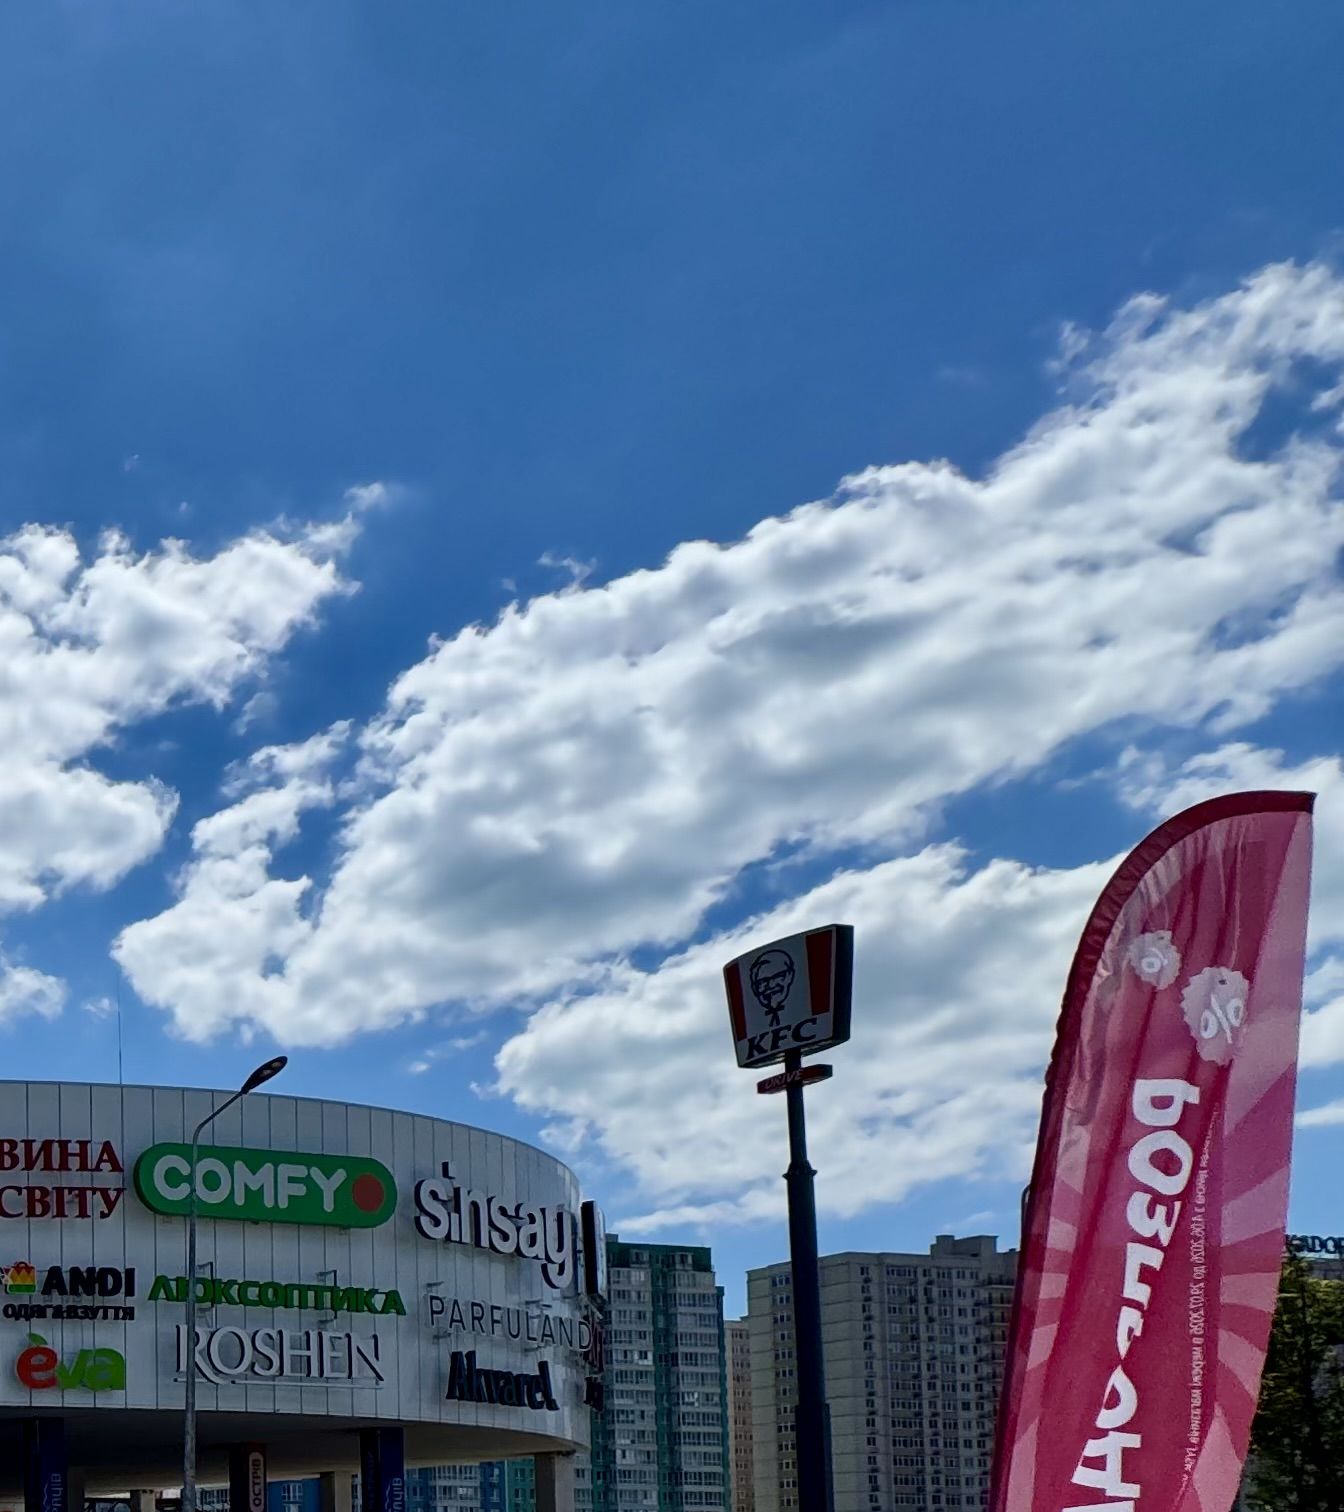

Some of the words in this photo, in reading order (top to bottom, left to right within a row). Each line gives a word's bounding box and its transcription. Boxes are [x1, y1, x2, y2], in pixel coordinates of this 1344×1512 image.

[745, 1018, 817, 1060] KFC
[764, 1069, 803, 1090] DRIVE
[153, 1154, 347, 1213] COMFY
[414, 1161, 576, 1290] sinsay
[41, 1265, 136, 1297] ANDI
[148, 1275, 407, 1316] ЛЮКСОПТИКА
[428, 1295, 593, 1350] PARFULAND
[175, 1324, 385, 1384] ROSHEN
[252, 1459, 262, 1508] ОСТРІВ
